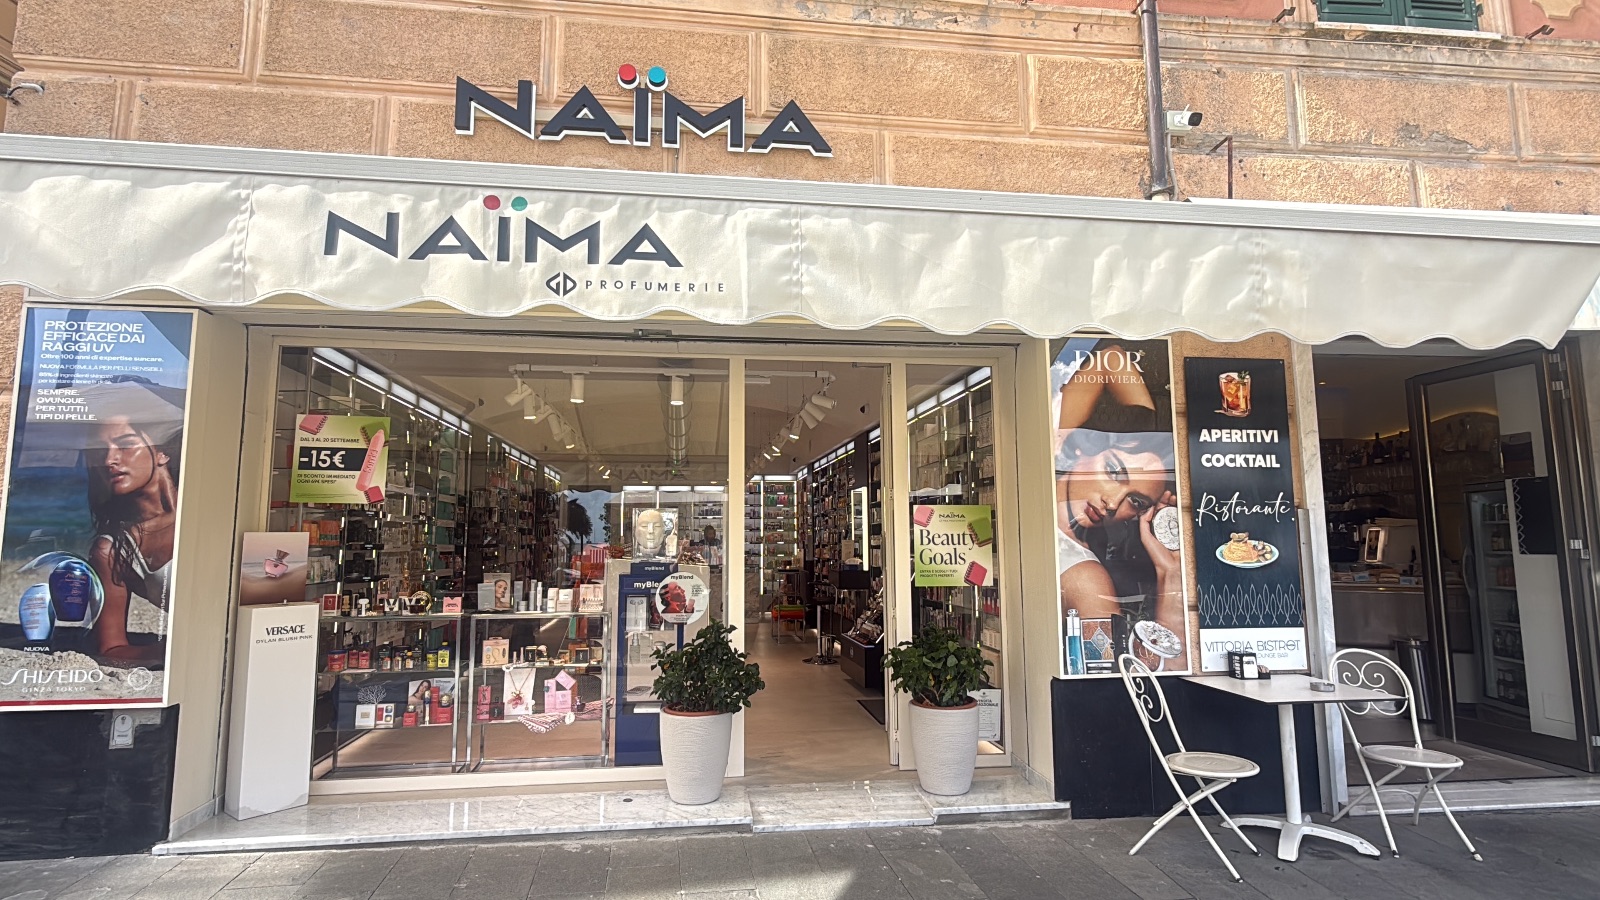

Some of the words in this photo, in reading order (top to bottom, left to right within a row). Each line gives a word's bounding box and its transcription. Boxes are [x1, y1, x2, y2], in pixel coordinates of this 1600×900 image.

[455, 64, 834, 157] NAÏMA
[323, 194, 684, 268] NAÏMA
[585, 280, 724, 292] PROFUMERIE
[44, 320, 143, 333] PROTEZIONE
[43, 331, 118, 343] EFFICACE
[119, 333, 145, 344] DAI
[42, 341, 90, 352] RAGGI
[93, 343, 115, 353] UV
[1073, 349, 1144, 373] DIOR
[1074, 375, 1145, 384] DIORIVIERA
[1199, 428, 1279, 443] APERITIVI
[299, 449, 346, 468] -15€
[1201, 453, 1280, 468] COCKTAIL
[939, 511, 966, 519] NAÏMA
[1197, 491, 1291, 527] Ristorante
[919, 529, 975, 550] Beauty
[919, 548, 966, 566] Goals
[633, 581, 661, 589] myBle
[265, 624, 306, 636] VERSACE
[1205, 641, 1253, 653] VITTORIA
[0, 668, 103, 686] SHISEIDO
